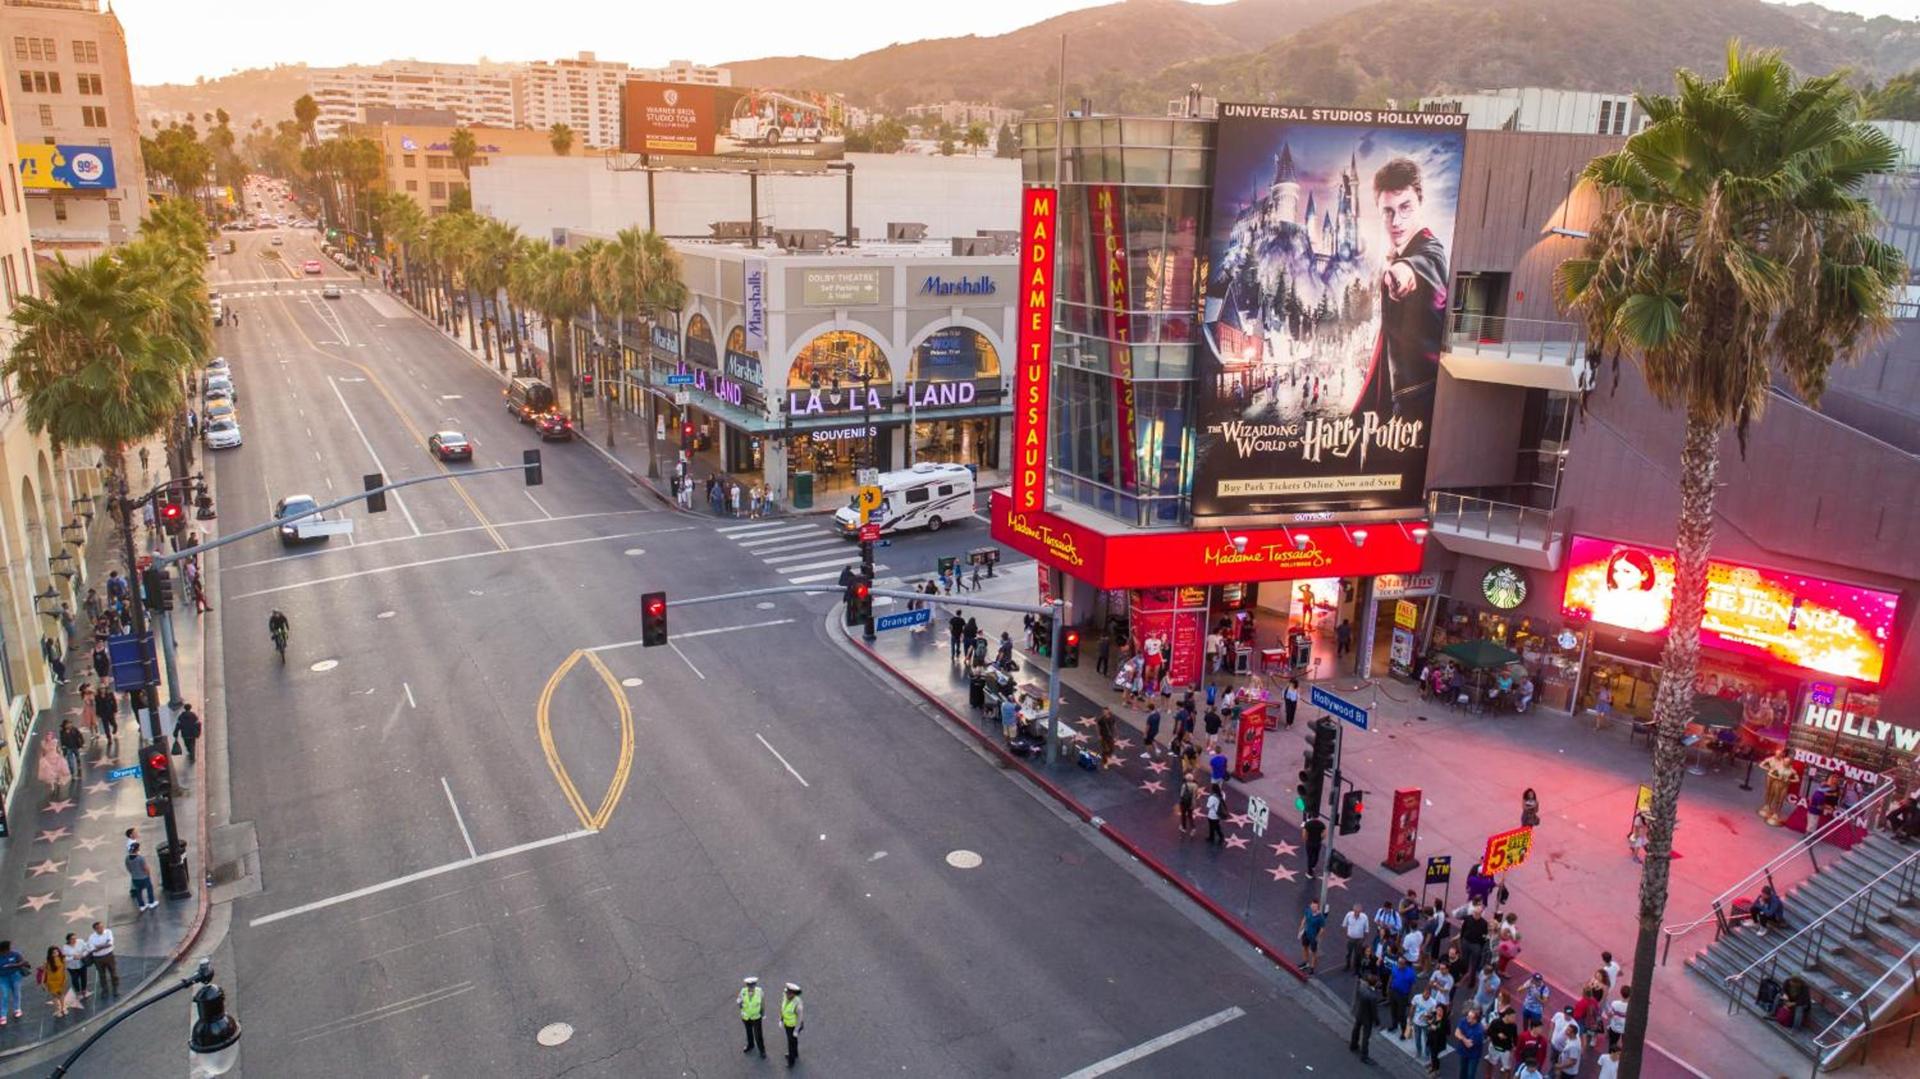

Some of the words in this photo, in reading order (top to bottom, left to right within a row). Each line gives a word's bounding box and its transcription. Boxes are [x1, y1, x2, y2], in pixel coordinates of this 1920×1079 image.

[646, 113, 674, 122] STUDIO
[675, 114, 696, 123] TOUR
[1224, 105, 1307, 120] UNIVERSAL
[1312, 108, 1372, 123] STUDIOS
[1377, 111, 1465, 125] HOLLYWOOD
[808, 274, 834, 282] DOLBY
[1030, 198, 1049, 330] MADAME
[919, 276, 996, 297] Marshalls
[748, 271, 762, 337] Marshalls
[694, 368, 706, 391] LA
[714, 376, 742, 406] LAND
[790, 392, 824, 416] LA
[850, 388, 881, 411] LA
[908, 382, 974, 407] LAND
[1024, 344, 1041, 507] TUSSAUDS
[1208, 425, 1222, 434] THE
[1300, 417, 1362, 463] Harry
[1361, 411, 1423, 473] Potter
[1223, 483, 1241, 493] Buy
[1244, 482, 1264, 492] Park
[1268, 481, 1300, 490] Tickets
[1303, 480, 1334, 489] Online
[1337, 479, 1356, 488] Now
[1359, 478, 1375, 487] and
[1378, 477, 1396, 486] Save
[1008, 512, 1041, 540] Madame
[1038, 525, 1078, 566] Tussauds
[1204, 544, 1264, 567] Madame
[1261, 540, 1325, 568] Tussauds
[882, 616, 914, 628] Orange
[916, 612, 926, 622] Dr
[1738, 598, 1857, 636] JENNER
[1314, 690, 1354, 718] Hollywood
[1428, 865, 1450, 876] ATM
